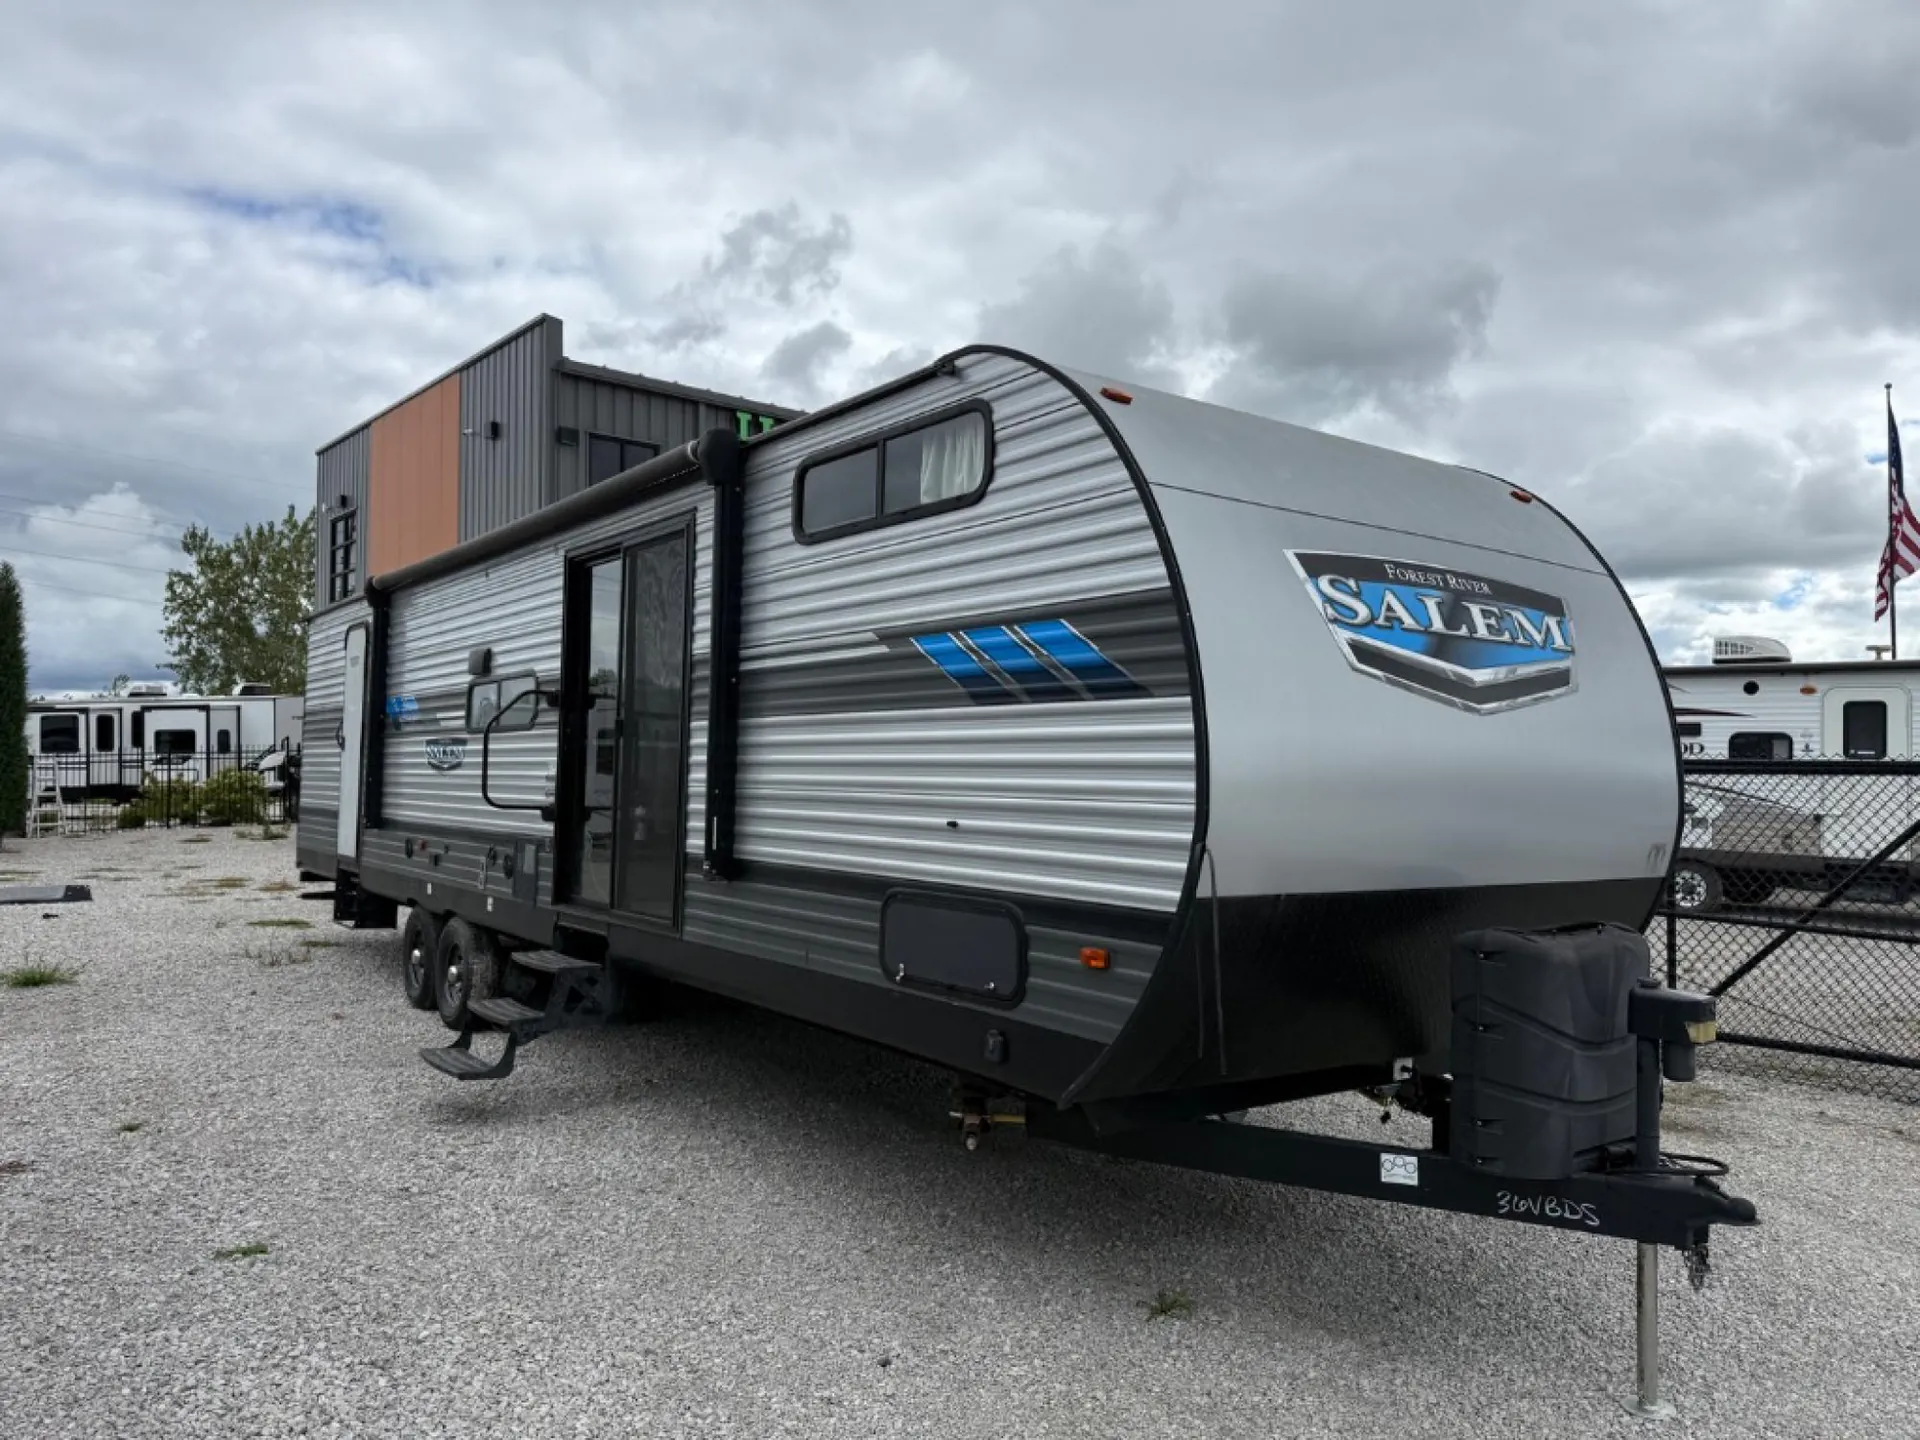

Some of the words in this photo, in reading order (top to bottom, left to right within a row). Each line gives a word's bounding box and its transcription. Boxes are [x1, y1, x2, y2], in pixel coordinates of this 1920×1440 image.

[1384, 563, 1444, 587] FOREST
[1445, 573, 1493, 595] RIVER
[1317, 574, 1574, 652] SALEM
